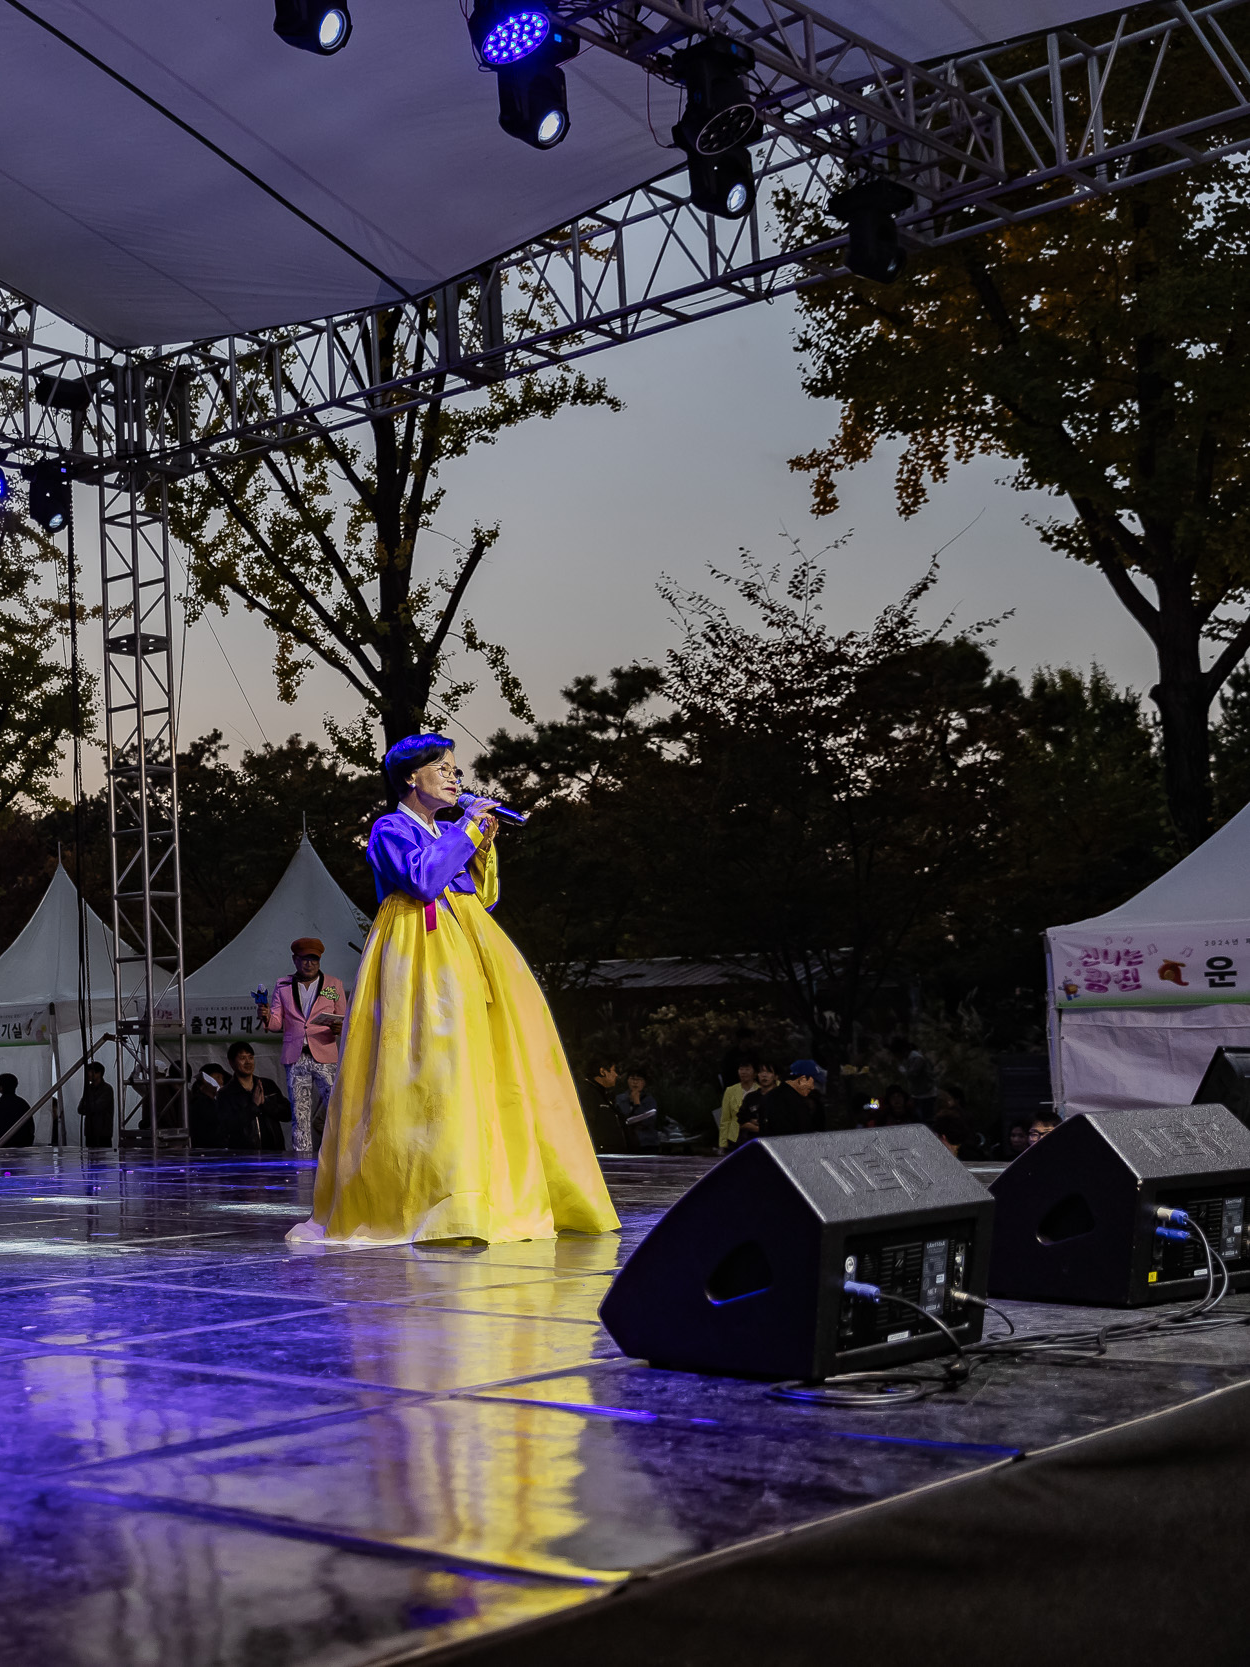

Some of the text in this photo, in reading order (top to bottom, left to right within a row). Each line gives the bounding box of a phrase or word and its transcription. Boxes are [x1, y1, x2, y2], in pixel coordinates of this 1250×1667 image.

[1078, 947, 1143, 967] 신나는
[1204, 956, 1237, 988] 운
[190, 1016, 233, 1034] 출연자
